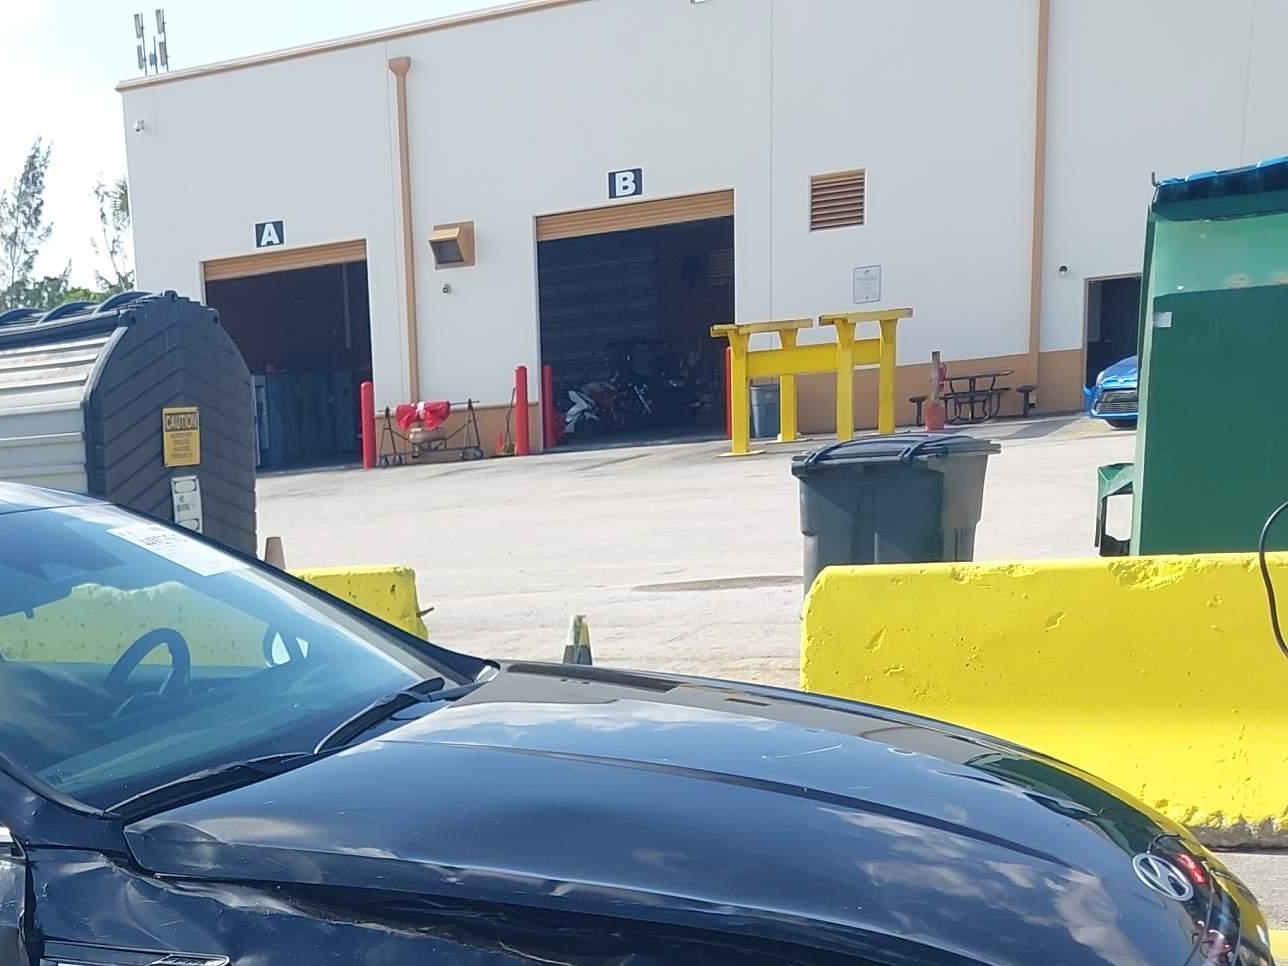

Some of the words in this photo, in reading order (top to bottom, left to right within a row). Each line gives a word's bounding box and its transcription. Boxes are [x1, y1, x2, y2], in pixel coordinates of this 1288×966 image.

[615, 171, 636, 197] B
[260, 223, 280, 246] A
[165, 414, 198, 430] CAUTION
